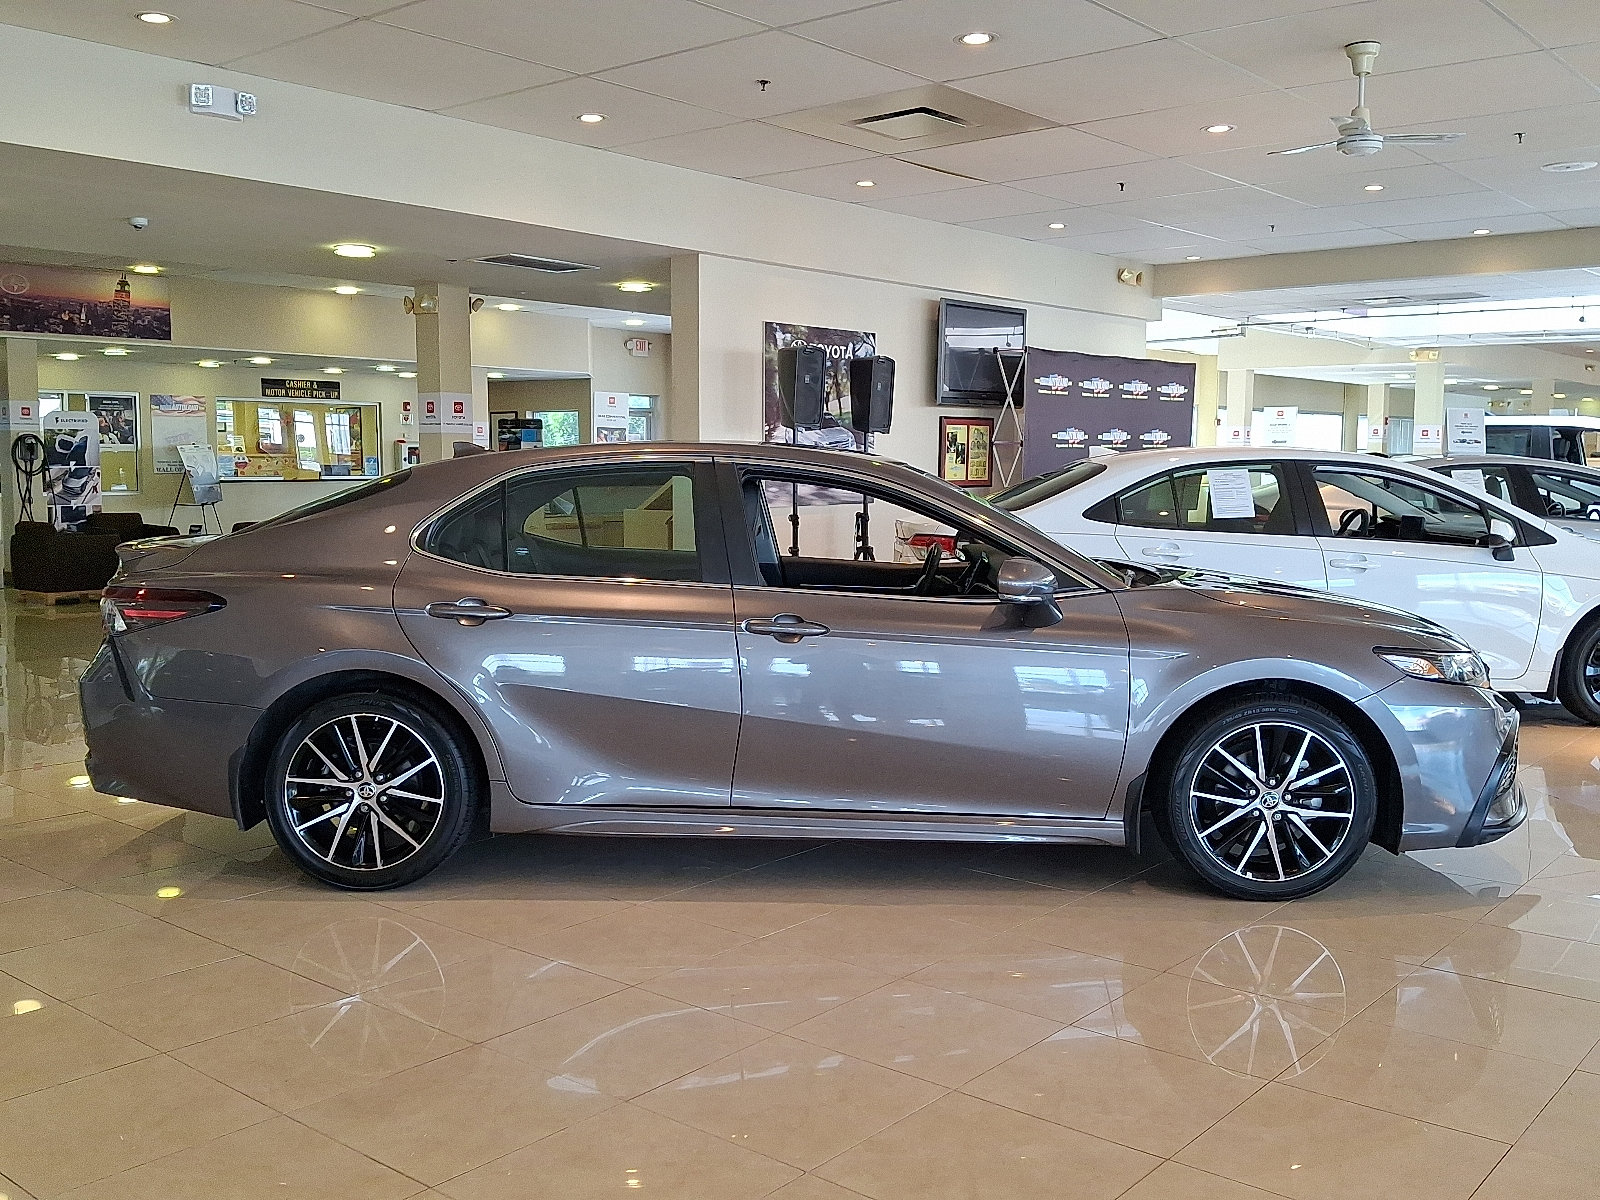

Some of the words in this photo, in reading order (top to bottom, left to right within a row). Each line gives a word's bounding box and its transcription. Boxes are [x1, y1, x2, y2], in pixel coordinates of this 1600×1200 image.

[636, 340, 646, 352] EXIT
[809, 342, 854, 360] YOTA
[285, 380, 311, 389] CASHIER
[312, 381, 318, 389] &
[265, 388, 286, 396] MOTOR
[287, 389, 312, 397] VEHICLE
[312, 390, 339, 399] PICK-UP
